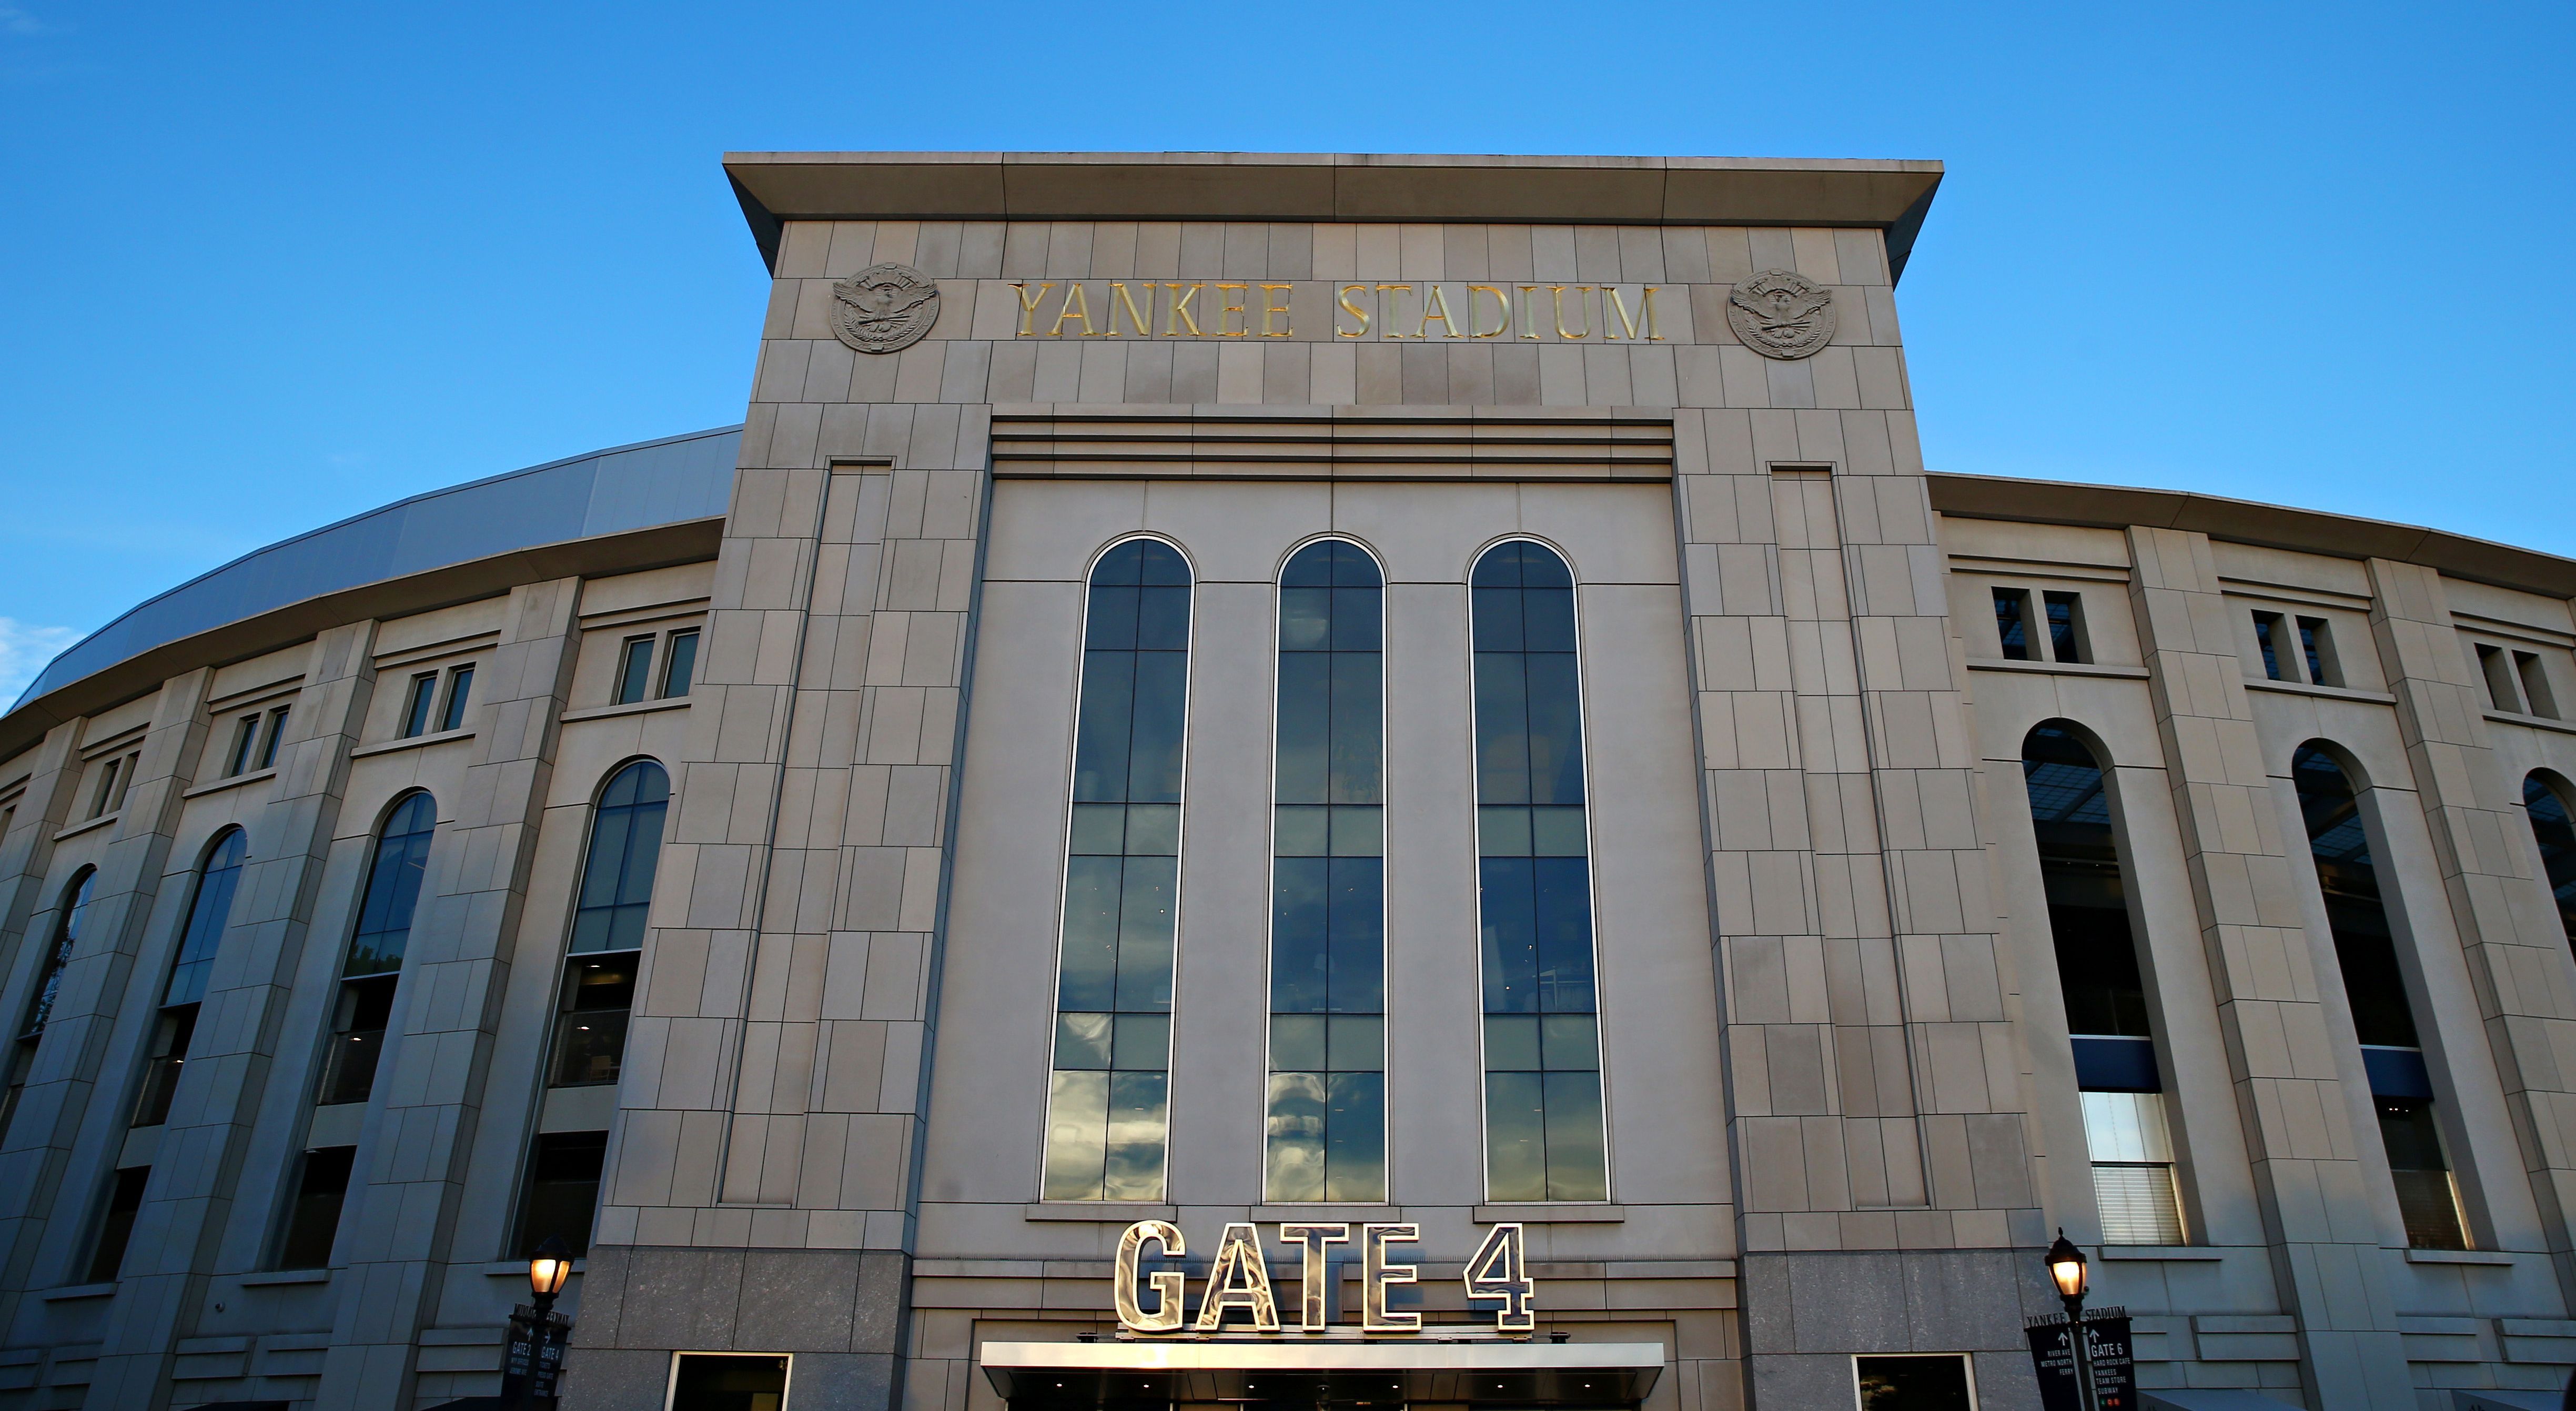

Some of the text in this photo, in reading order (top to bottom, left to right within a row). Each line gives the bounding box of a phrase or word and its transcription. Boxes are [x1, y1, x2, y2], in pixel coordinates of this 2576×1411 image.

[1007, 283, 1665, 340] YANKEE STADIUM
[1114, 1219, 1536, 1332] GATE 4
[2026, 1306, 2126, 1327] YANKEE STADIUM
[512, 1342, 531, 1356] GATE 2
[541, 1347, 555, 1360] GATE
[2091, 1343, 2123, 1357] GATE 6
